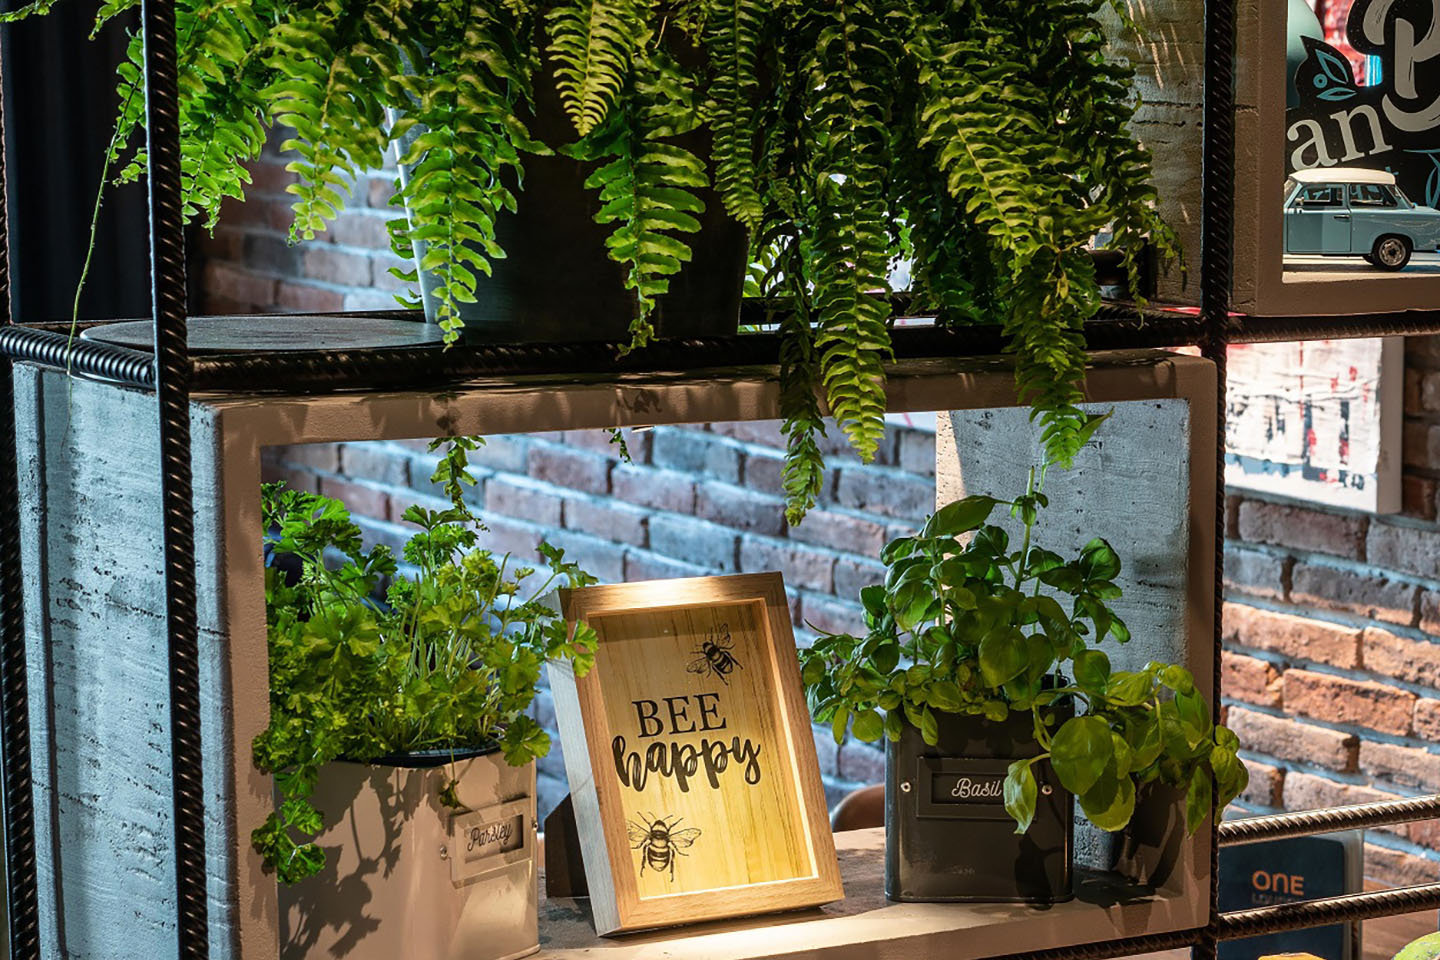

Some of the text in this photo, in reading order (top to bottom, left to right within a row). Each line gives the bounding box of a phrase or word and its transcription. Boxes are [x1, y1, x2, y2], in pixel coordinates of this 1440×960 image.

[632, 693, 727, 738] BEE
[612, 735, 761, 793] happy
[951, 777, 1003, 798] Basil
[467, 823, 513, 852] Parsley
